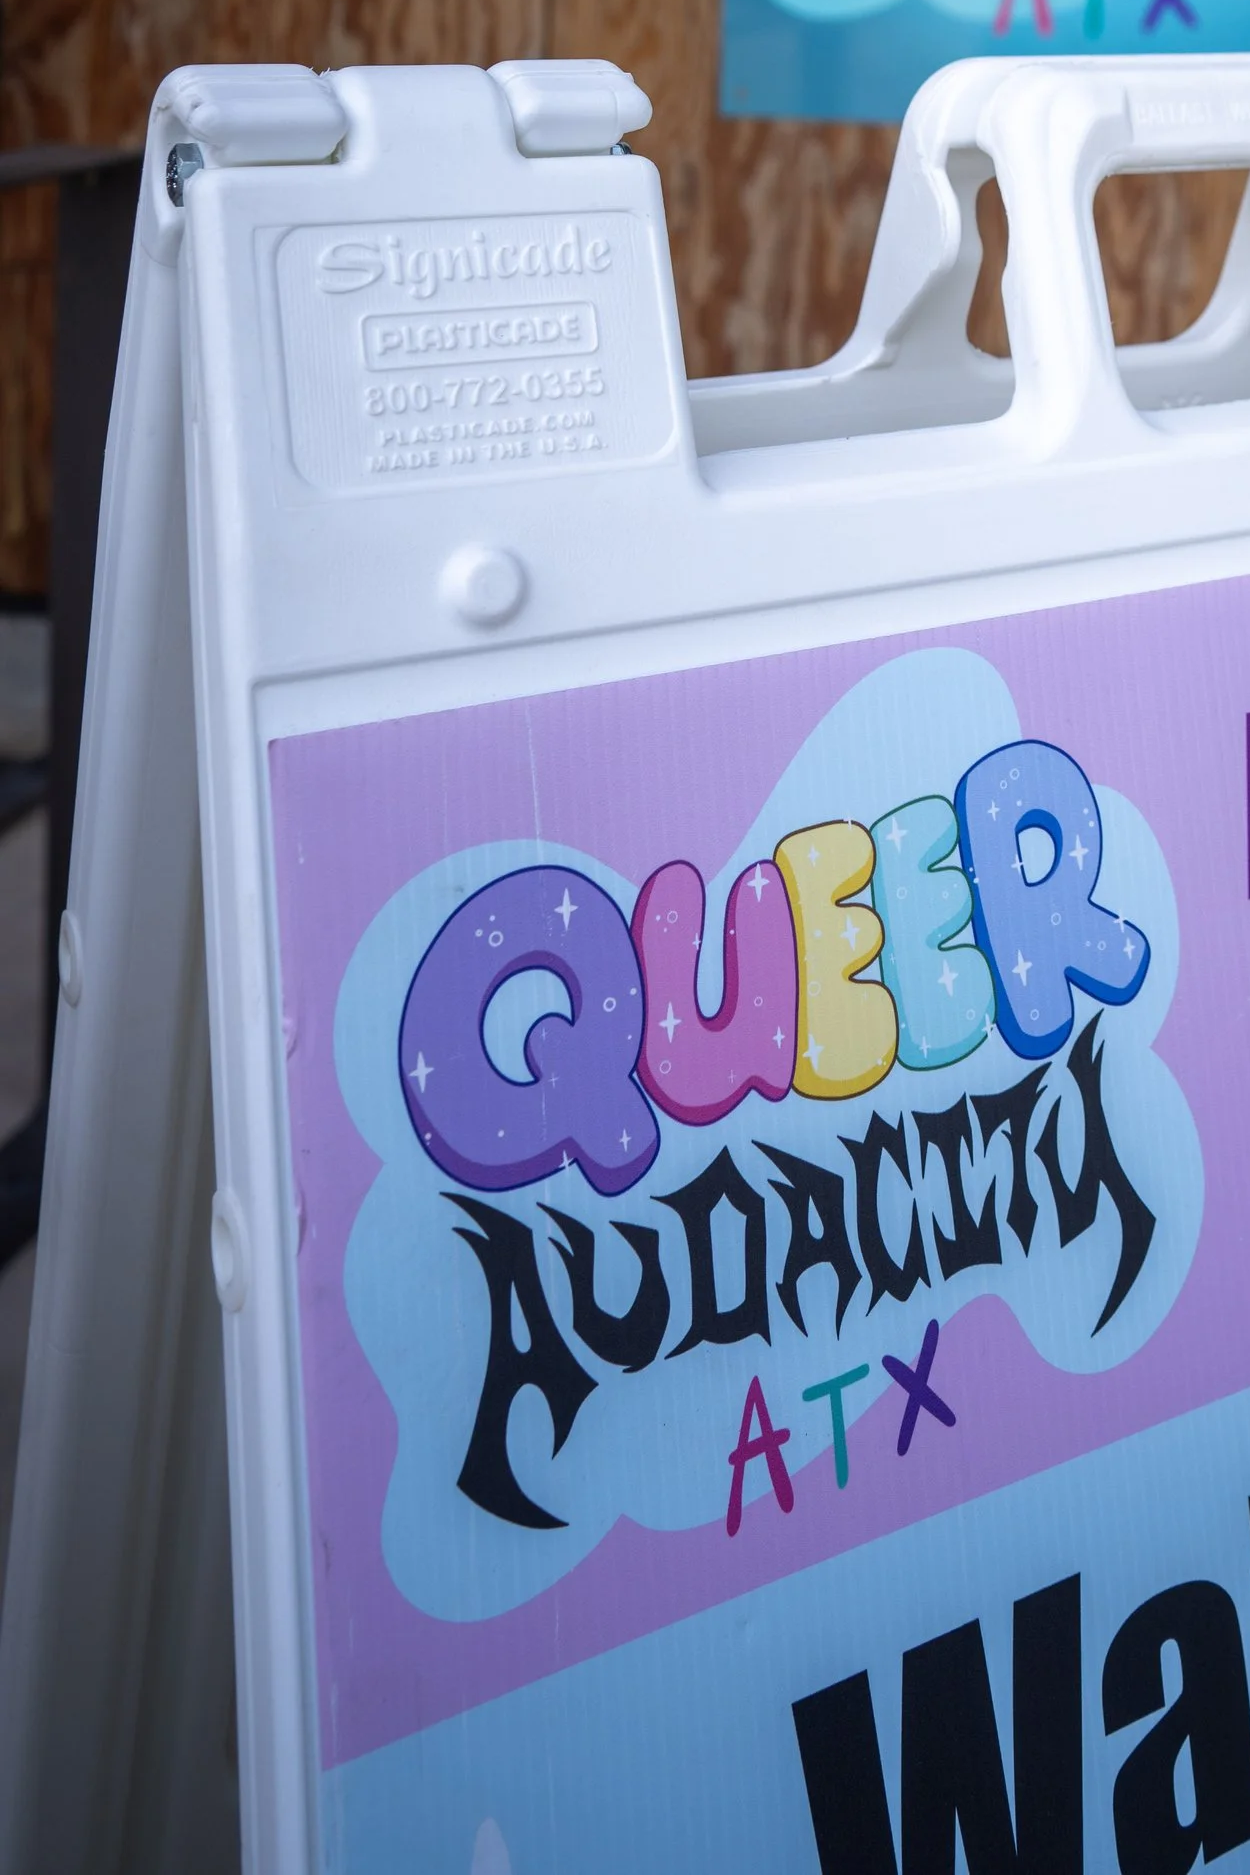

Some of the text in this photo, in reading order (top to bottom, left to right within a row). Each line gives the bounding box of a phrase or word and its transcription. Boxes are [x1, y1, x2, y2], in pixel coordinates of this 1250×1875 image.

[315, 225, 613, 299] Signicade
[375, 314, 581, 356] PLASTICADE
[363, 366, 606, 418] 800-772-0355
[368, 432, 609, 474] MADE IN THE U.S.A.
[379, 410, 596, 448] PLASTICADE.COM
[399, 739, 1150, 1197] QUEER
[439, 1009, 1157, 1530] AUDACITY
[727, 1319, 957, 1537] ATX
